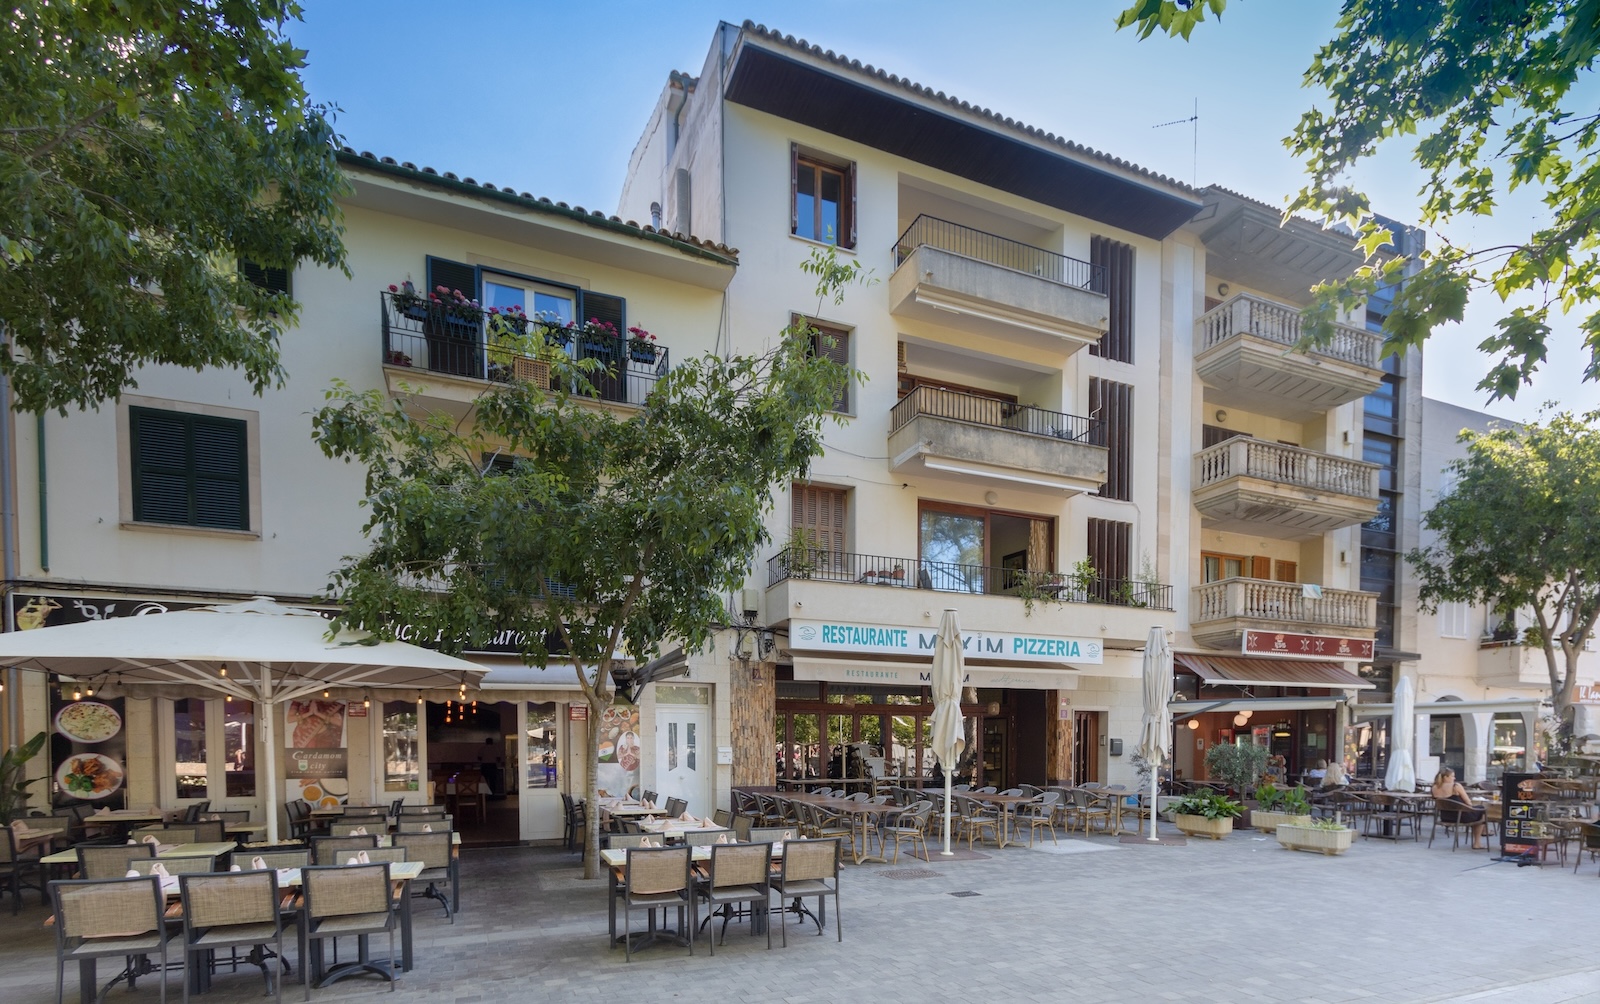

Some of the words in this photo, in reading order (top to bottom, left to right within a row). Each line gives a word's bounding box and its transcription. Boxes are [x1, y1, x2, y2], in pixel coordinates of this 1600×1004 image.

[822, 624, 908, 648] RESTAURANTE
[918, 633, 1003, 654] MXIM
[1013, 637, 1081, 657] PIZZERIA
[846, 669, 898, 679] RESTAURANTE
[292, 750, 342, 760] Cardamom
[309, 762, 327, 770] city
